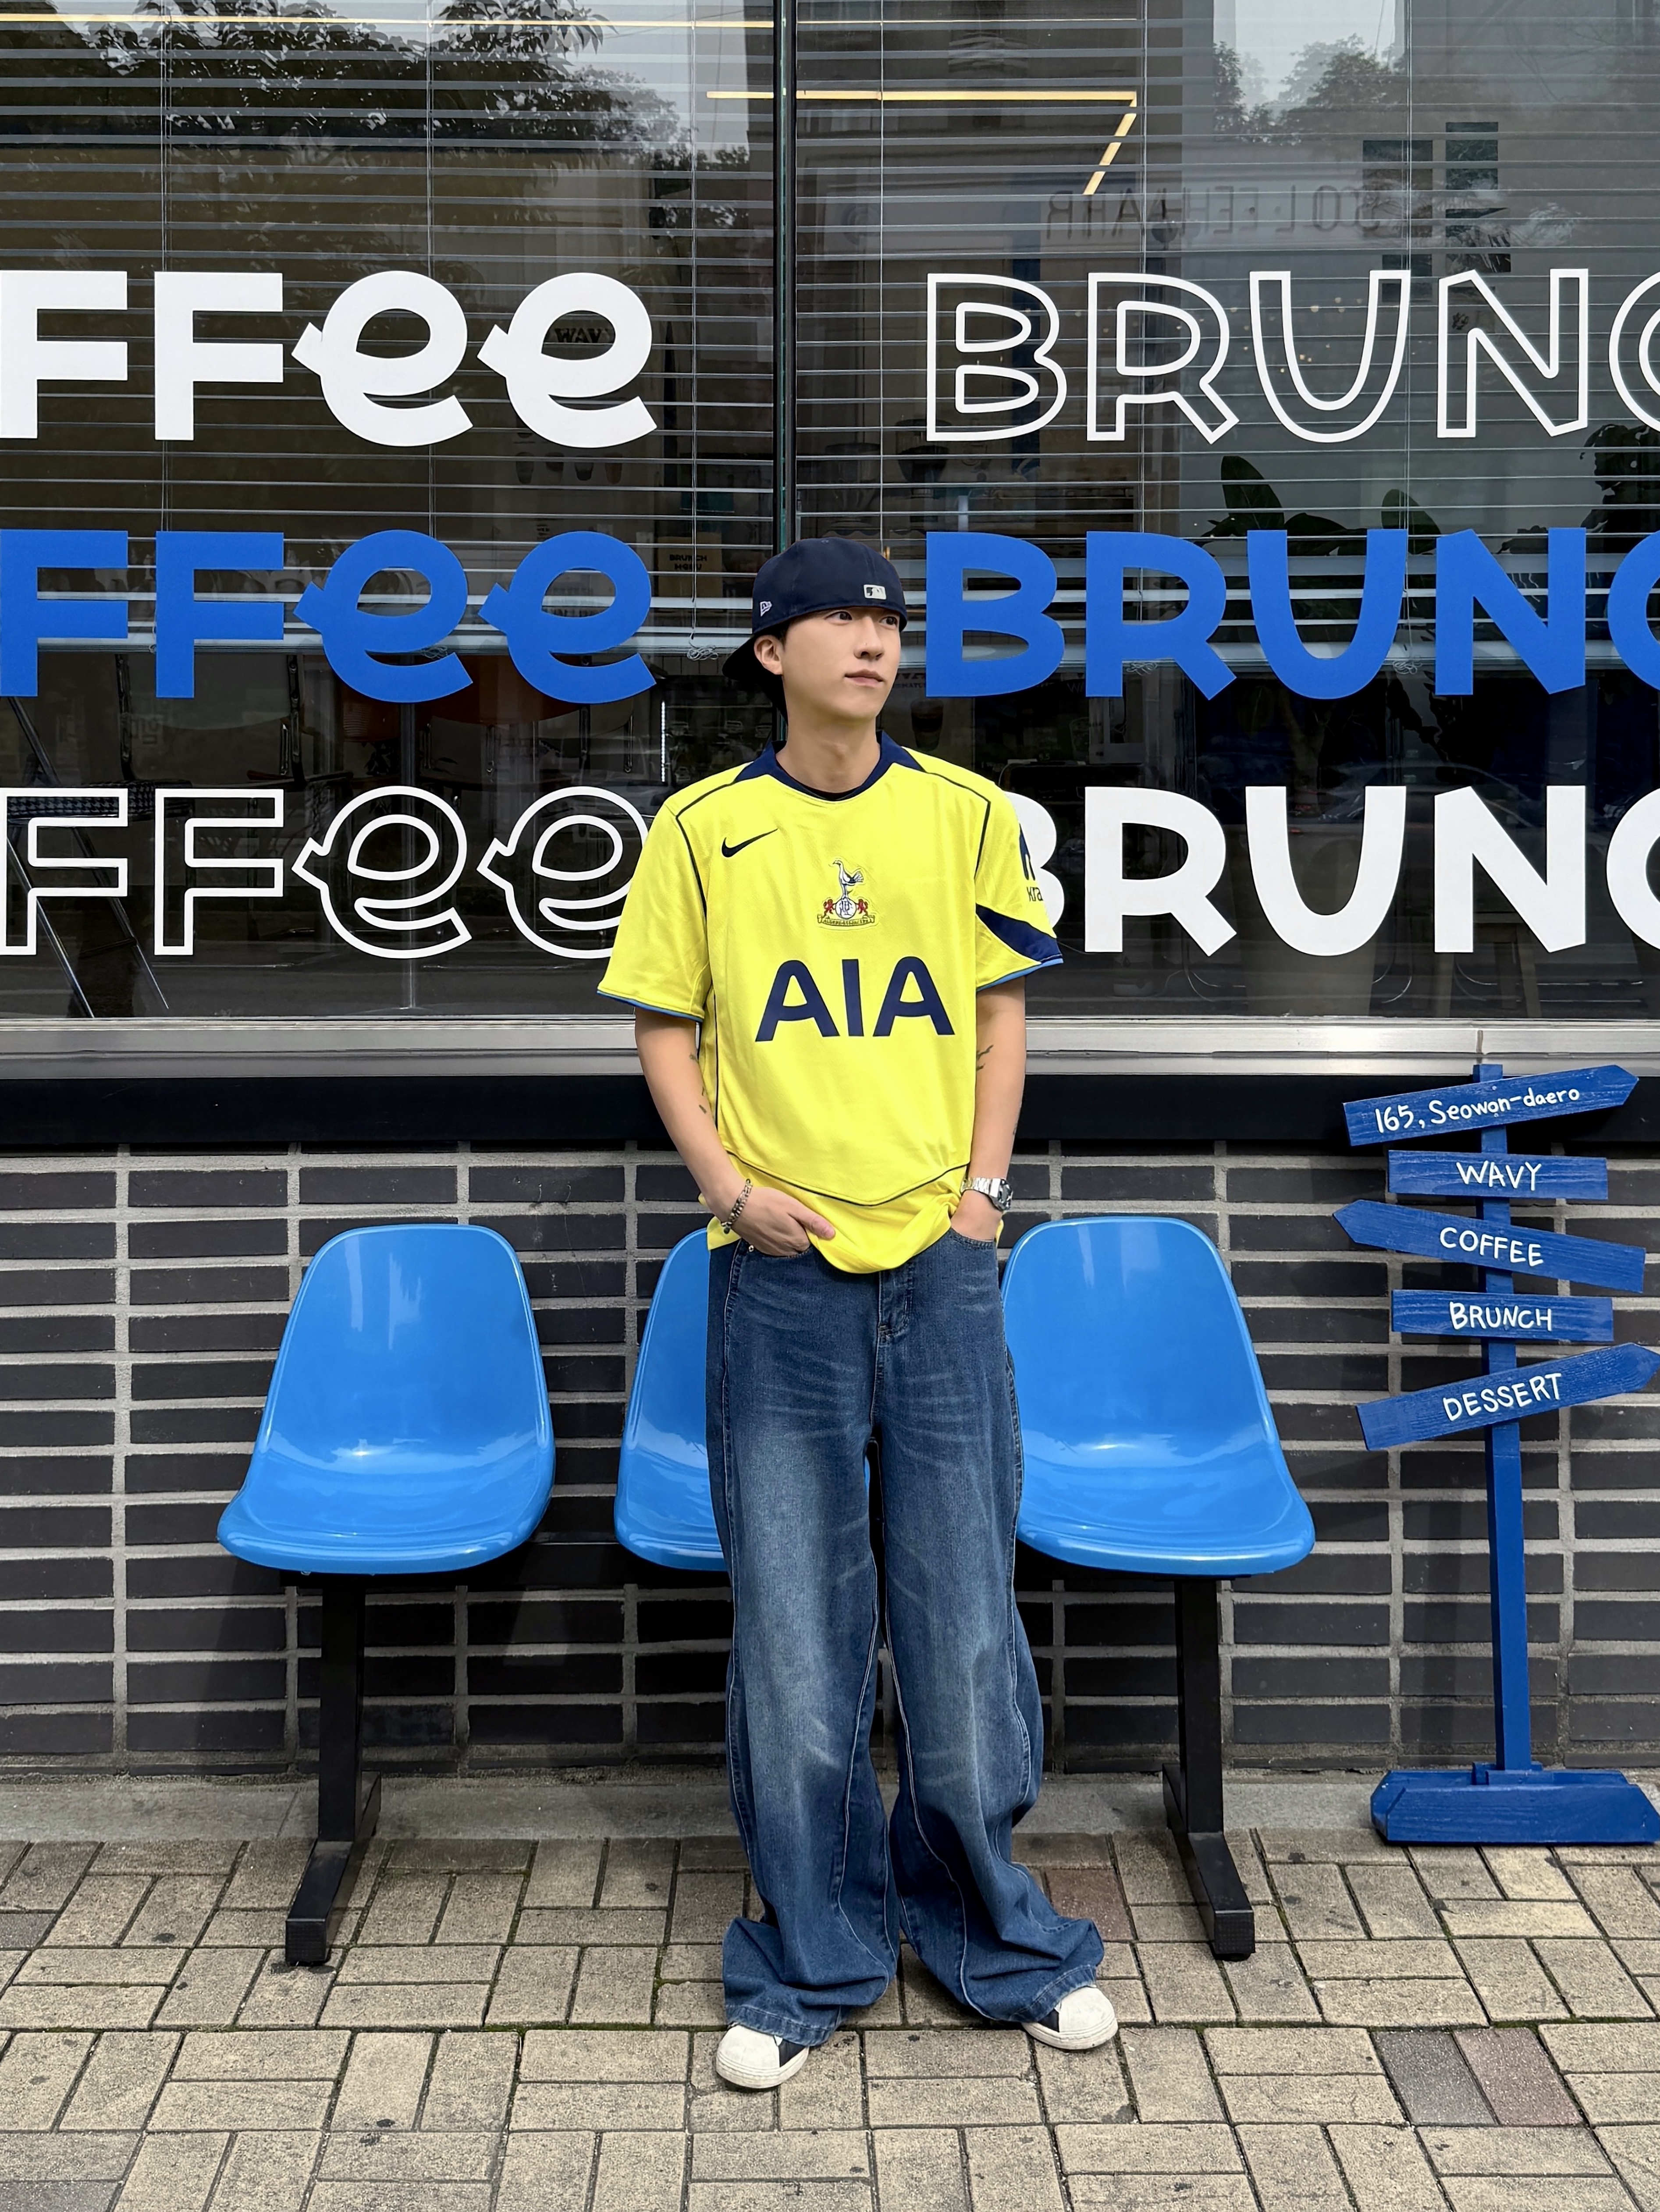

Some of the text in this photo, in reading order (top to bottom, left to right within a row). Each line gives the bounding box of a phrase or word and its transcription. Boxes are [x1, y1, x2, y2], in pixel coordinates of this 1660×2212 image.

[755, 956, 955, 1042] AIA
[1375, 1087, 1580, 1133] 165, Seowon-daero
[1456, 1161, 1541, 1191] WAVY
[1440, 1227, 1543, 1266] COFFEE
[1449, 1302, 1552, 1331] BRUNCH
[1443, 1373, 1561, 1421] DESSERT
